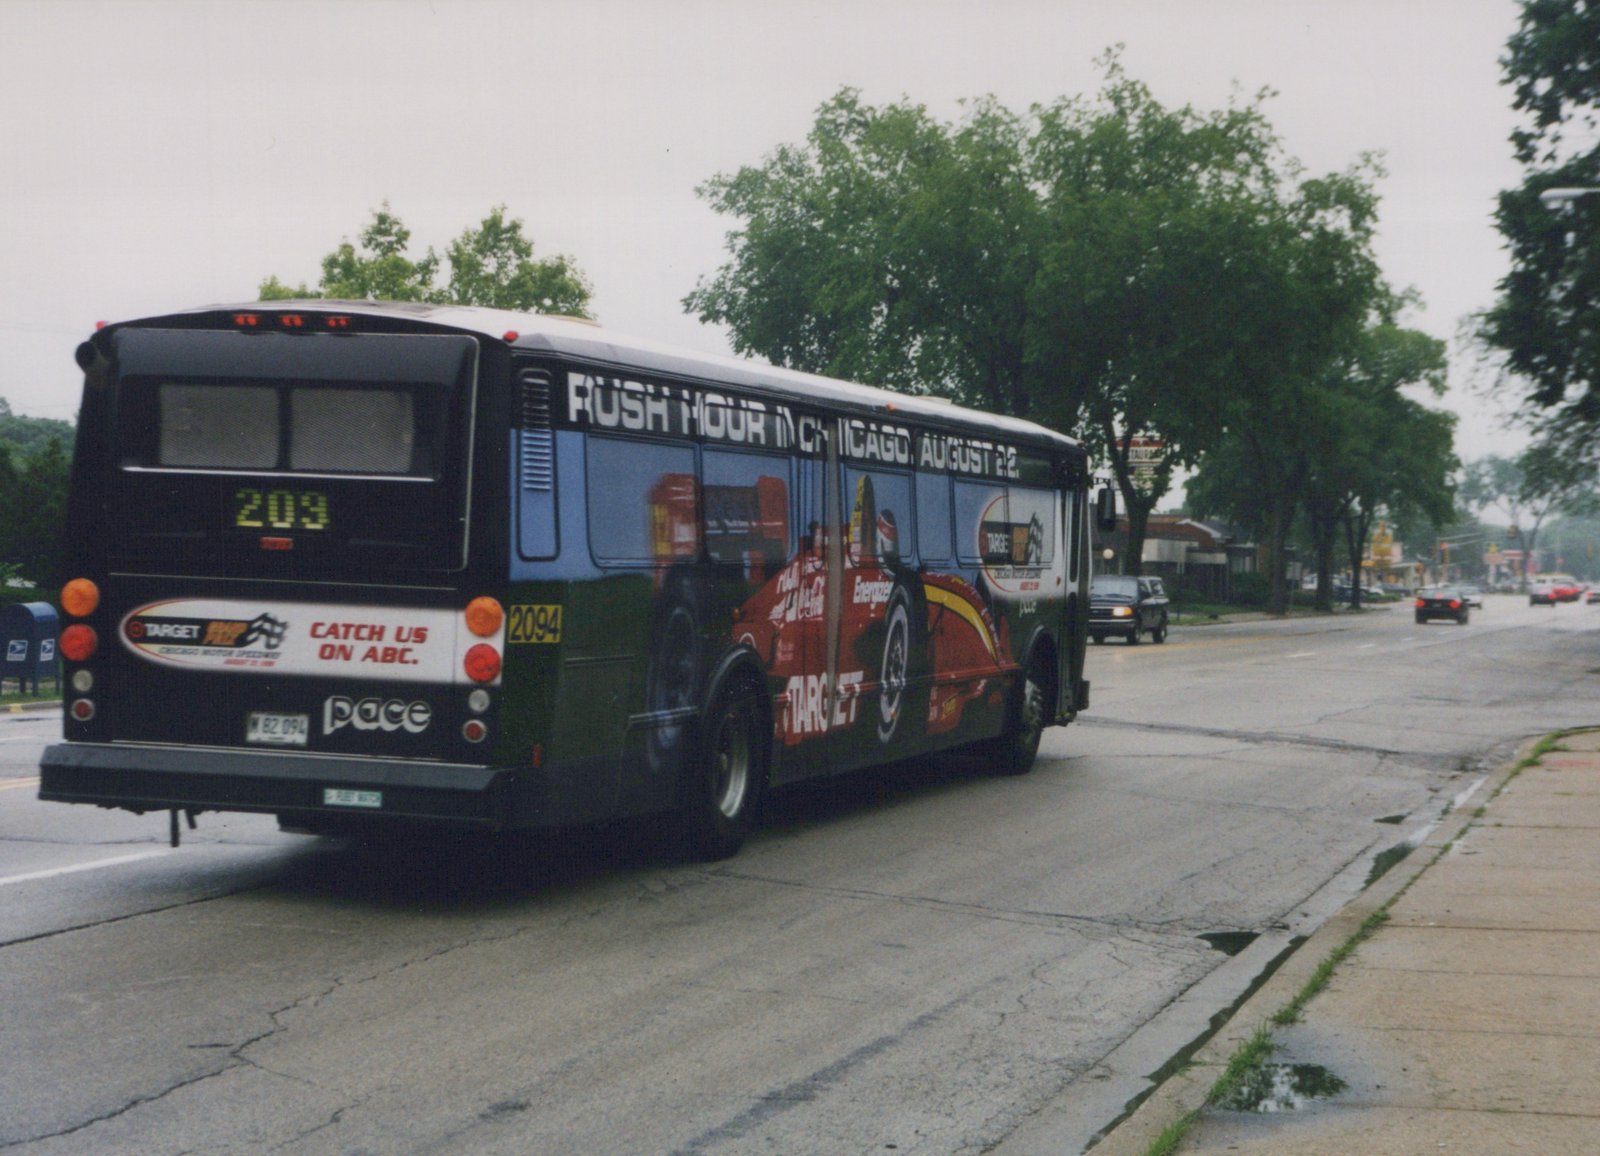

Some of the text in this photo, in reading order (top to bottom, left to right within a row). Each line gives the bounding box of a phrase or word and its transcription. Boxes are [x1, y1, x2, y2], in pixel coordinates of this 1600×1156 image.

[567, 371, 670, 433] RUSH
[681, 388, 767, 446] HOUR
[775, 404, 796, 449] IN
[920, 431, 994, 476] AUGUST
[236, 488, 330, 530] 209
[987, 532, 1009, 554] TARGE
[853, 575, 895, 610] Energizer
[144, 622, 201, 639] TARGET
[309, 622, 429, 644] CATCH US
[510, 606, 560, 641] 2094
[318, 643, 419, 665] ON ABC.
[322, 695, 432, 736] pace
[787, 670, 864, 734] TARGET
